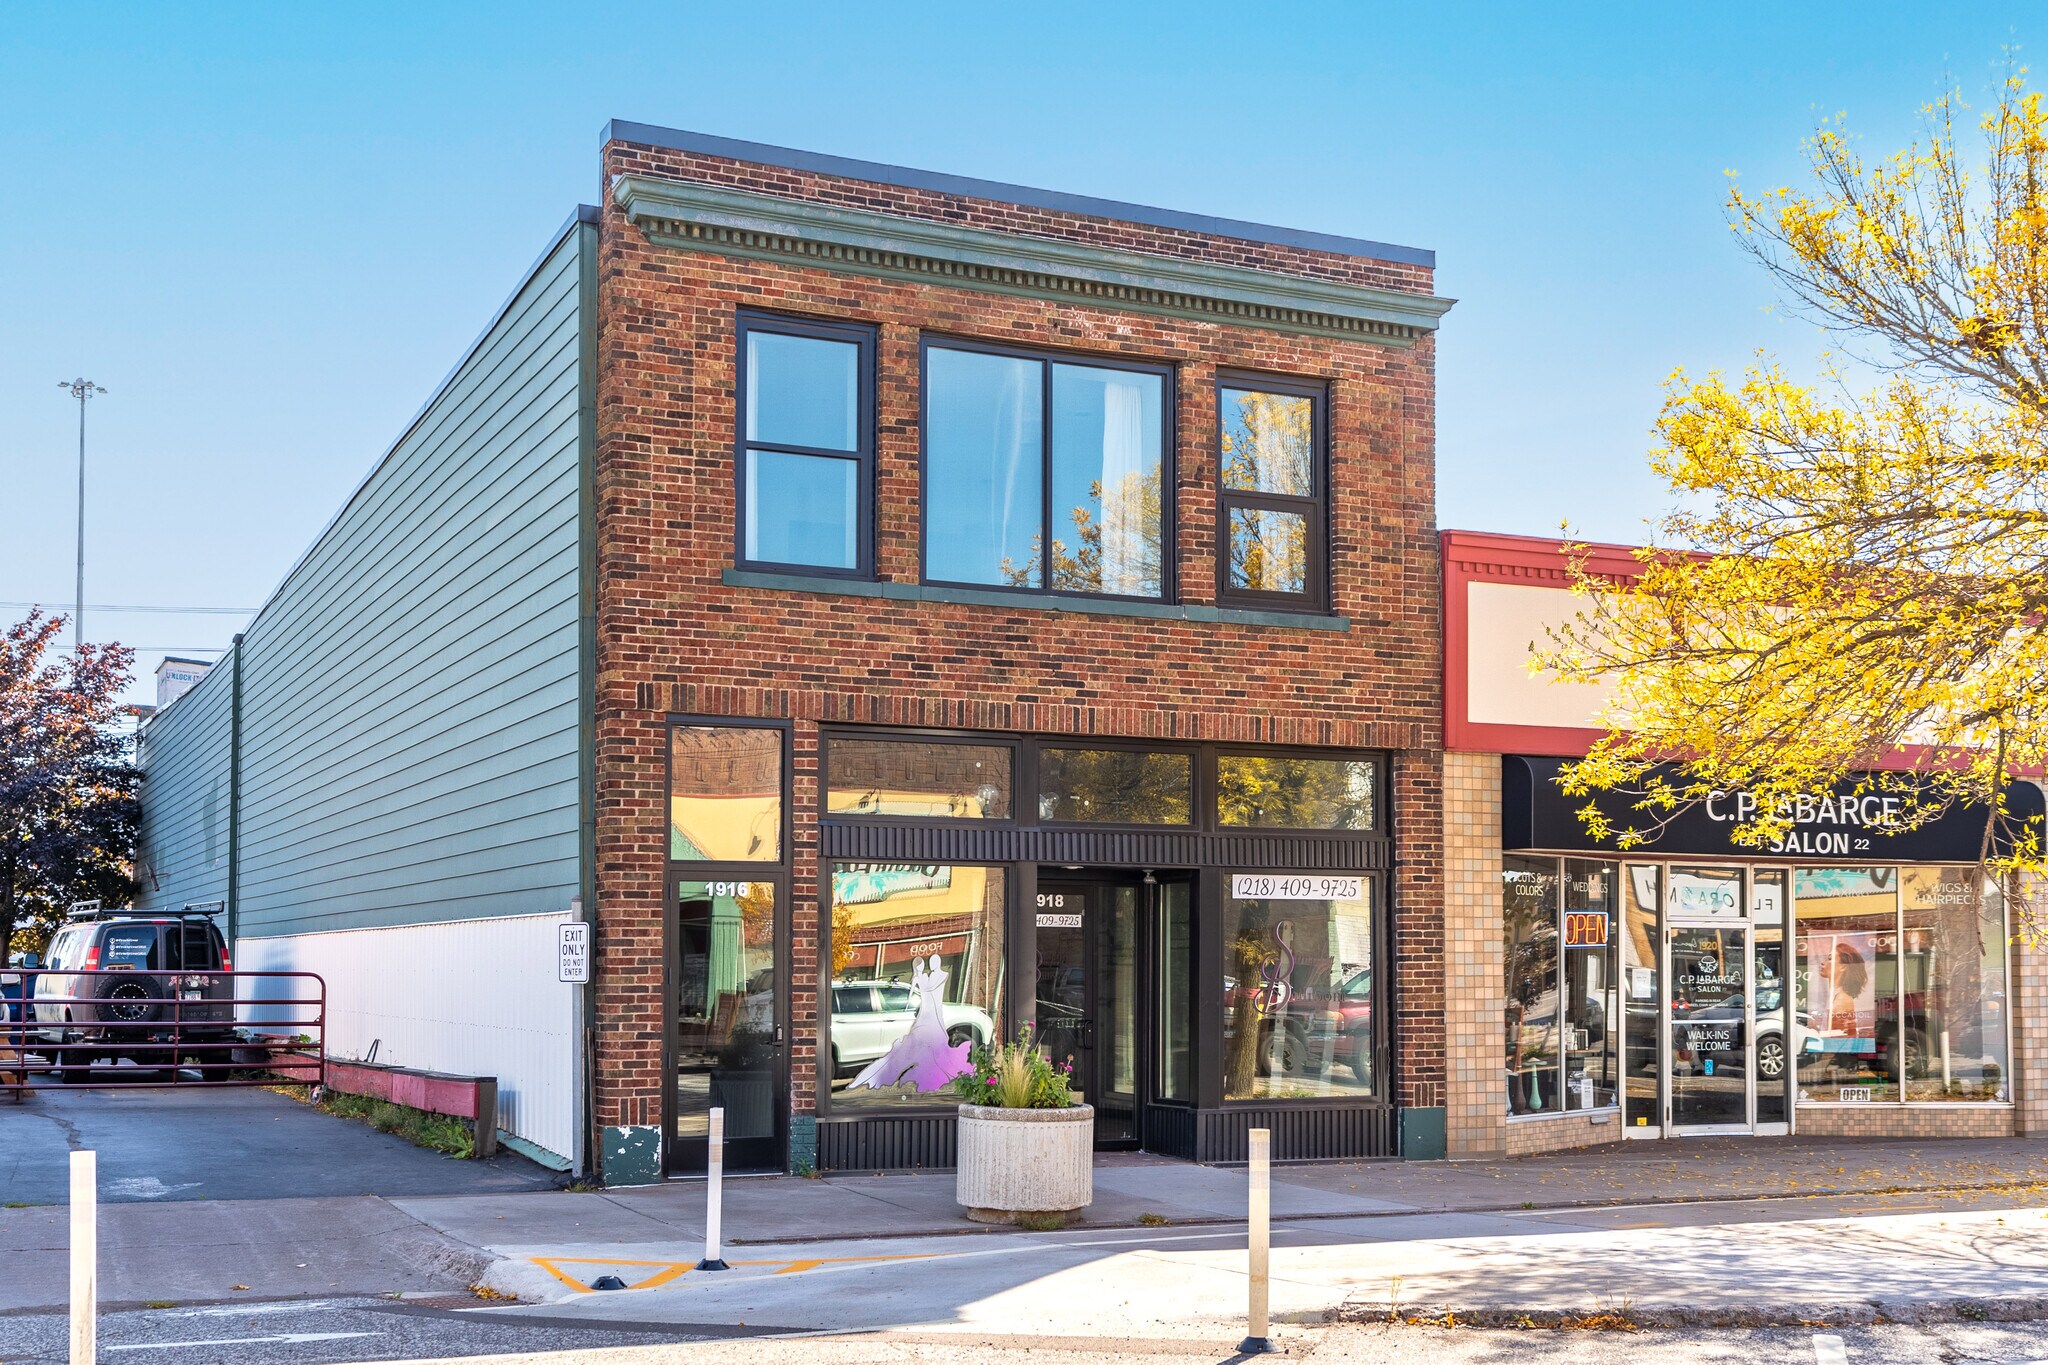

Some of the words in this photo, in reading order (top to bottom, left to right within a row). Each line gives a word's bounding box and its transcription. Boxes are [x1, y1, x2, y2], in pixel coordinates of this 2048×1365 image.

[1706, 790, 1757, 822] C.P.
[1770, 832, 1849, 855] SALON
[1854, 839, 1870, 850] 22
[705, 881, 749, 897] 1916
[1237, 877, 1276, 896] (218)
[1280, 879, 1357, 897] 409-9725
[1515, 885, 1544, 896] COLORS
[1932, 882, 1961, 893] WIGS
[1915, 894, 1986, 905] HAIRPIECS
[1565, 914, 1608, 945] OPEN
[565, 930, 583, 942] EXIT
[562, 944, 585, 956] ONLY
[1699, 941, 1718, 951] 1920
[563, 958, 571, 967] DO
[573, 958, 584, 967] NOT
[564, 968, 583, 976] ENTER
[1679, 975, 1695, 984] C.P.
[1698, 985, 1721, 993] SALON
[1687, 1030, 1729, 1040] WALK-INS
[1686, 1041, 1731, 1051] WELCOME
[1843, 1089, 1868, 1101] OPEN
